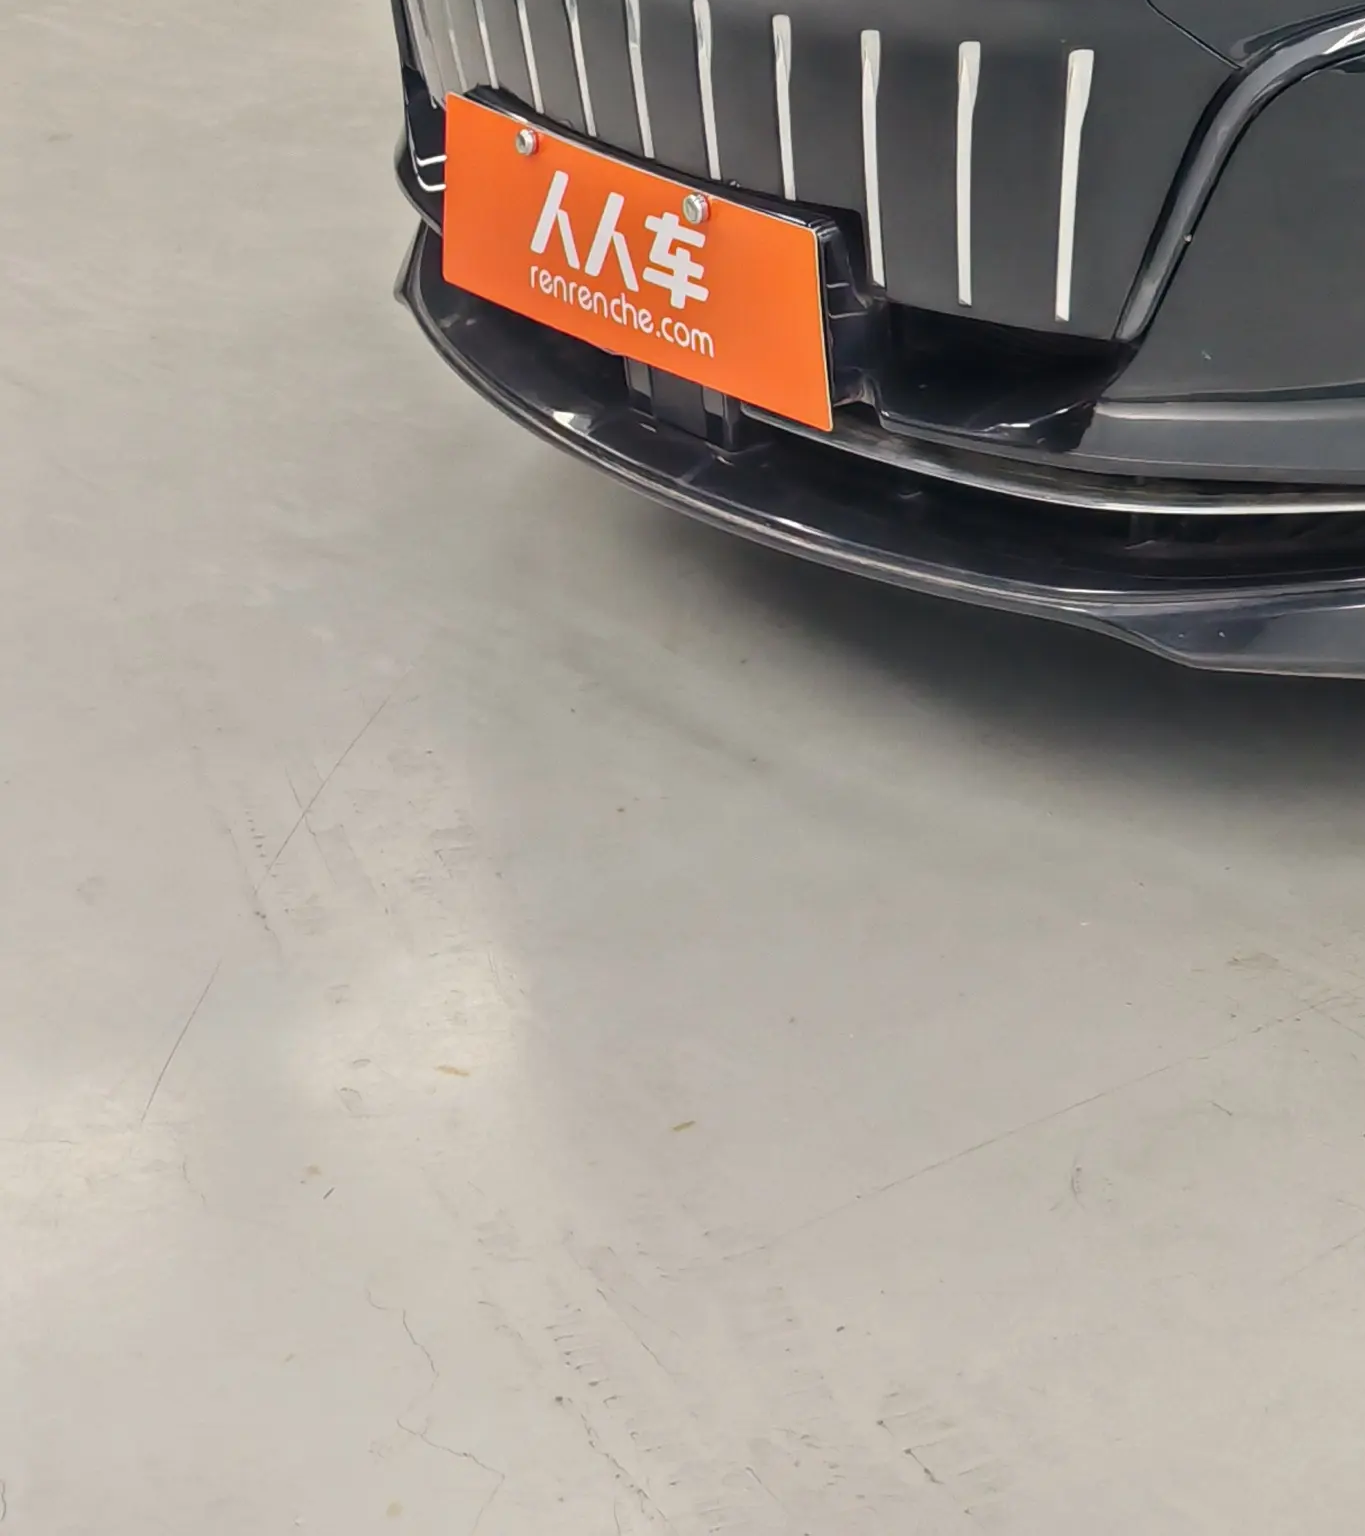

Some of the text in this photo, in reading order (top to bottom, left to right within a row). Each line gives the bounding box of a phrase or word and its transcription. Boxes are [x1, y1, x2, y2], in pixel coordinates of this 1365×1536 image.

[530, 170, 709, 309] 人人车
[529, 264, 715, 358] renrenche.com
